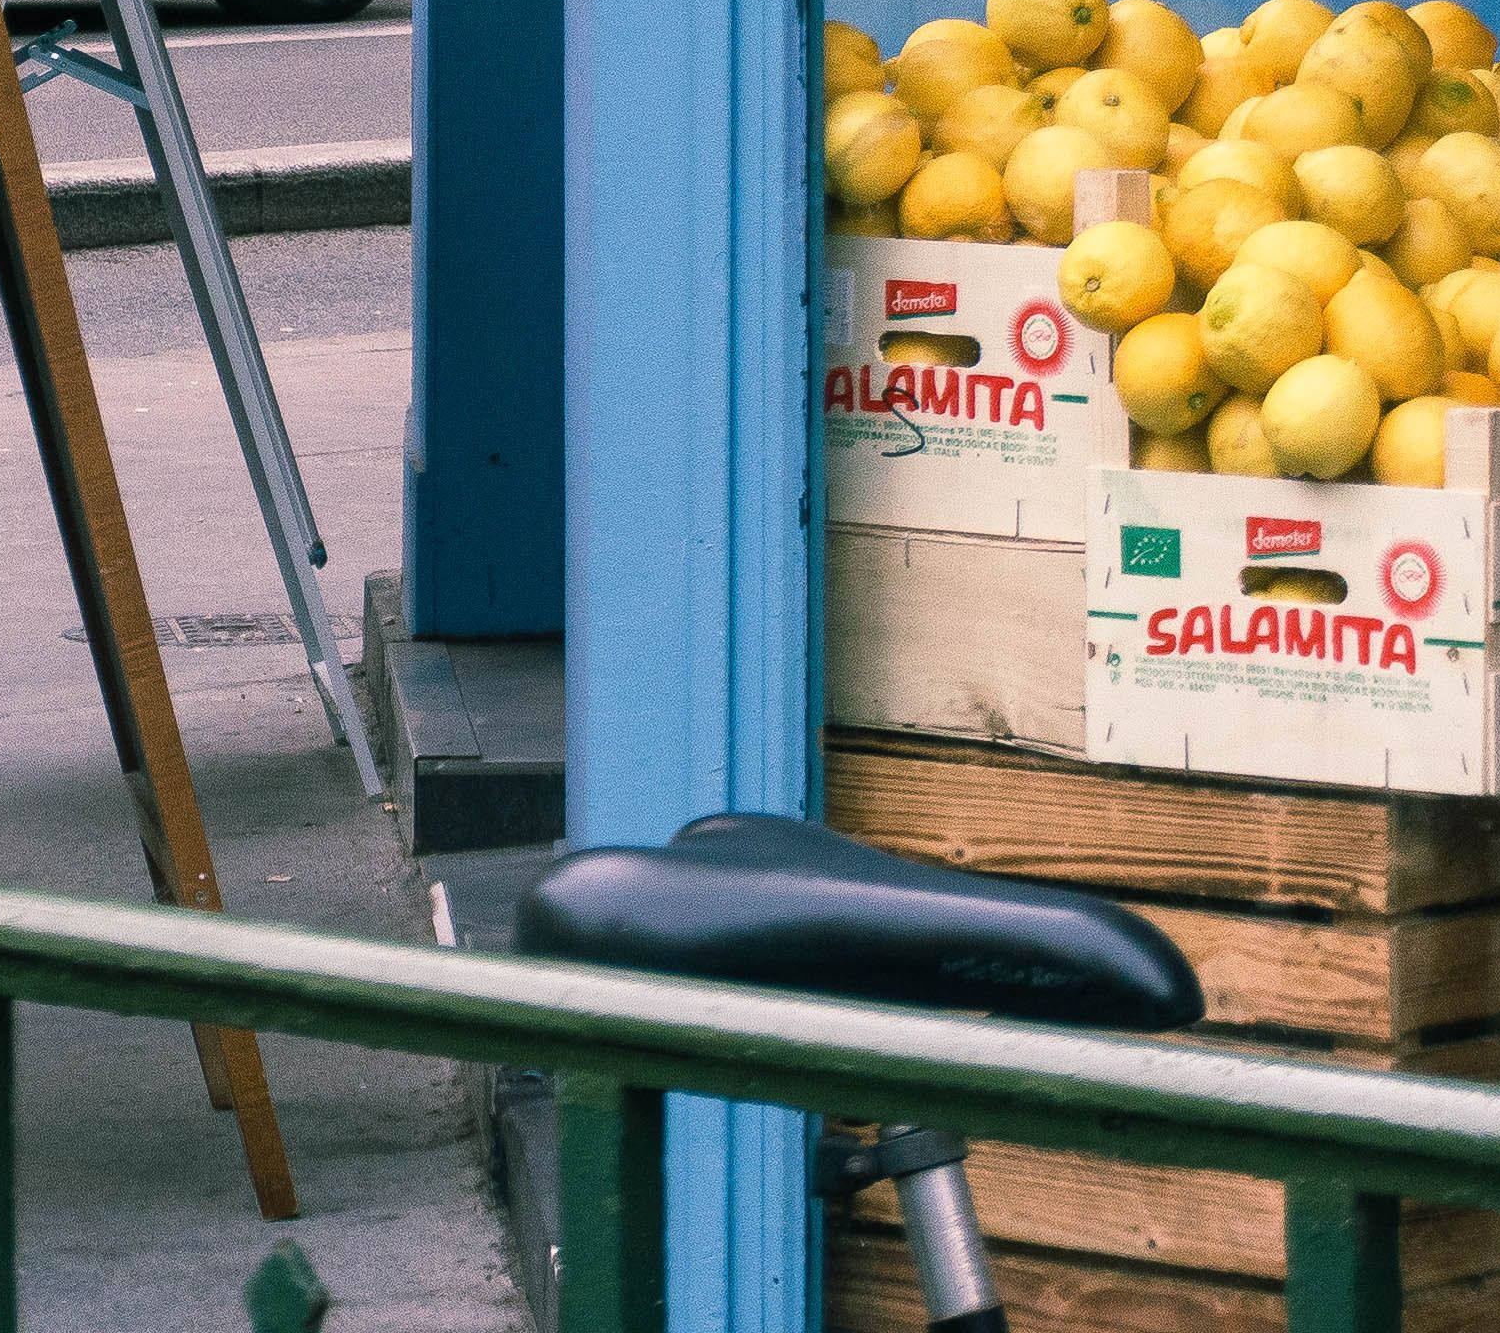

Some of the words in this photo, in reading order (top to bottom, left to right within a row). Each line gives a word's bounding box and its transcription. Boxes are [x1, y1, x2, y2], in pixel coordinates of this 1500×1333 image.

[890, 289, 949, 313] demeter
[823, 364, 1045, 432] ALAMITA
[1252, 527, 1314, 551] demeter
[1145, 604, 1417, 676] SALAMITA
